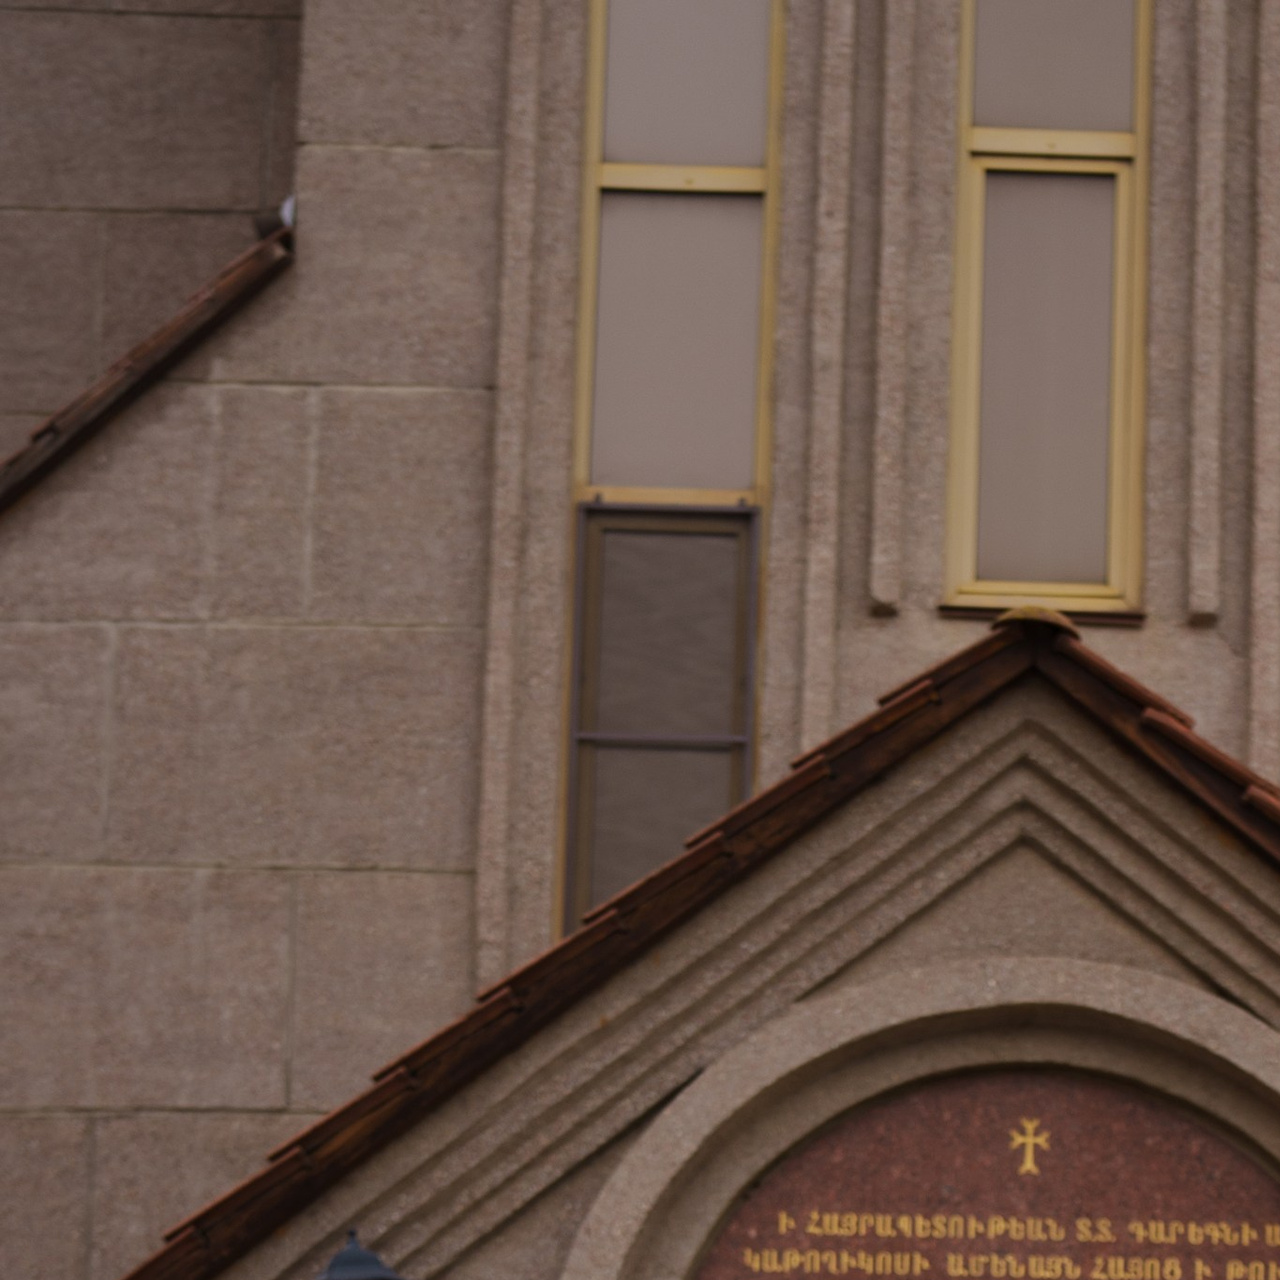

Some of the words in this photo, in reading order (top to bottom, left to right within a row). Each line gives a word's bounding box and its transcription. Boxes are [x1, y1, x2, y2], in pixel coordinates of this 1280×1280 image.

[779, 1211, 796, 1234] Ի
[1128, 1220, 1259, 1246] ԳԱՐԵԳՆԻ
[743, 1248, 930, 1276] ԿԱԹՈՂԻԿՈՍԻ
[947, 1253, 1082, 1280] ԱՄԵՆԱՅՆ
